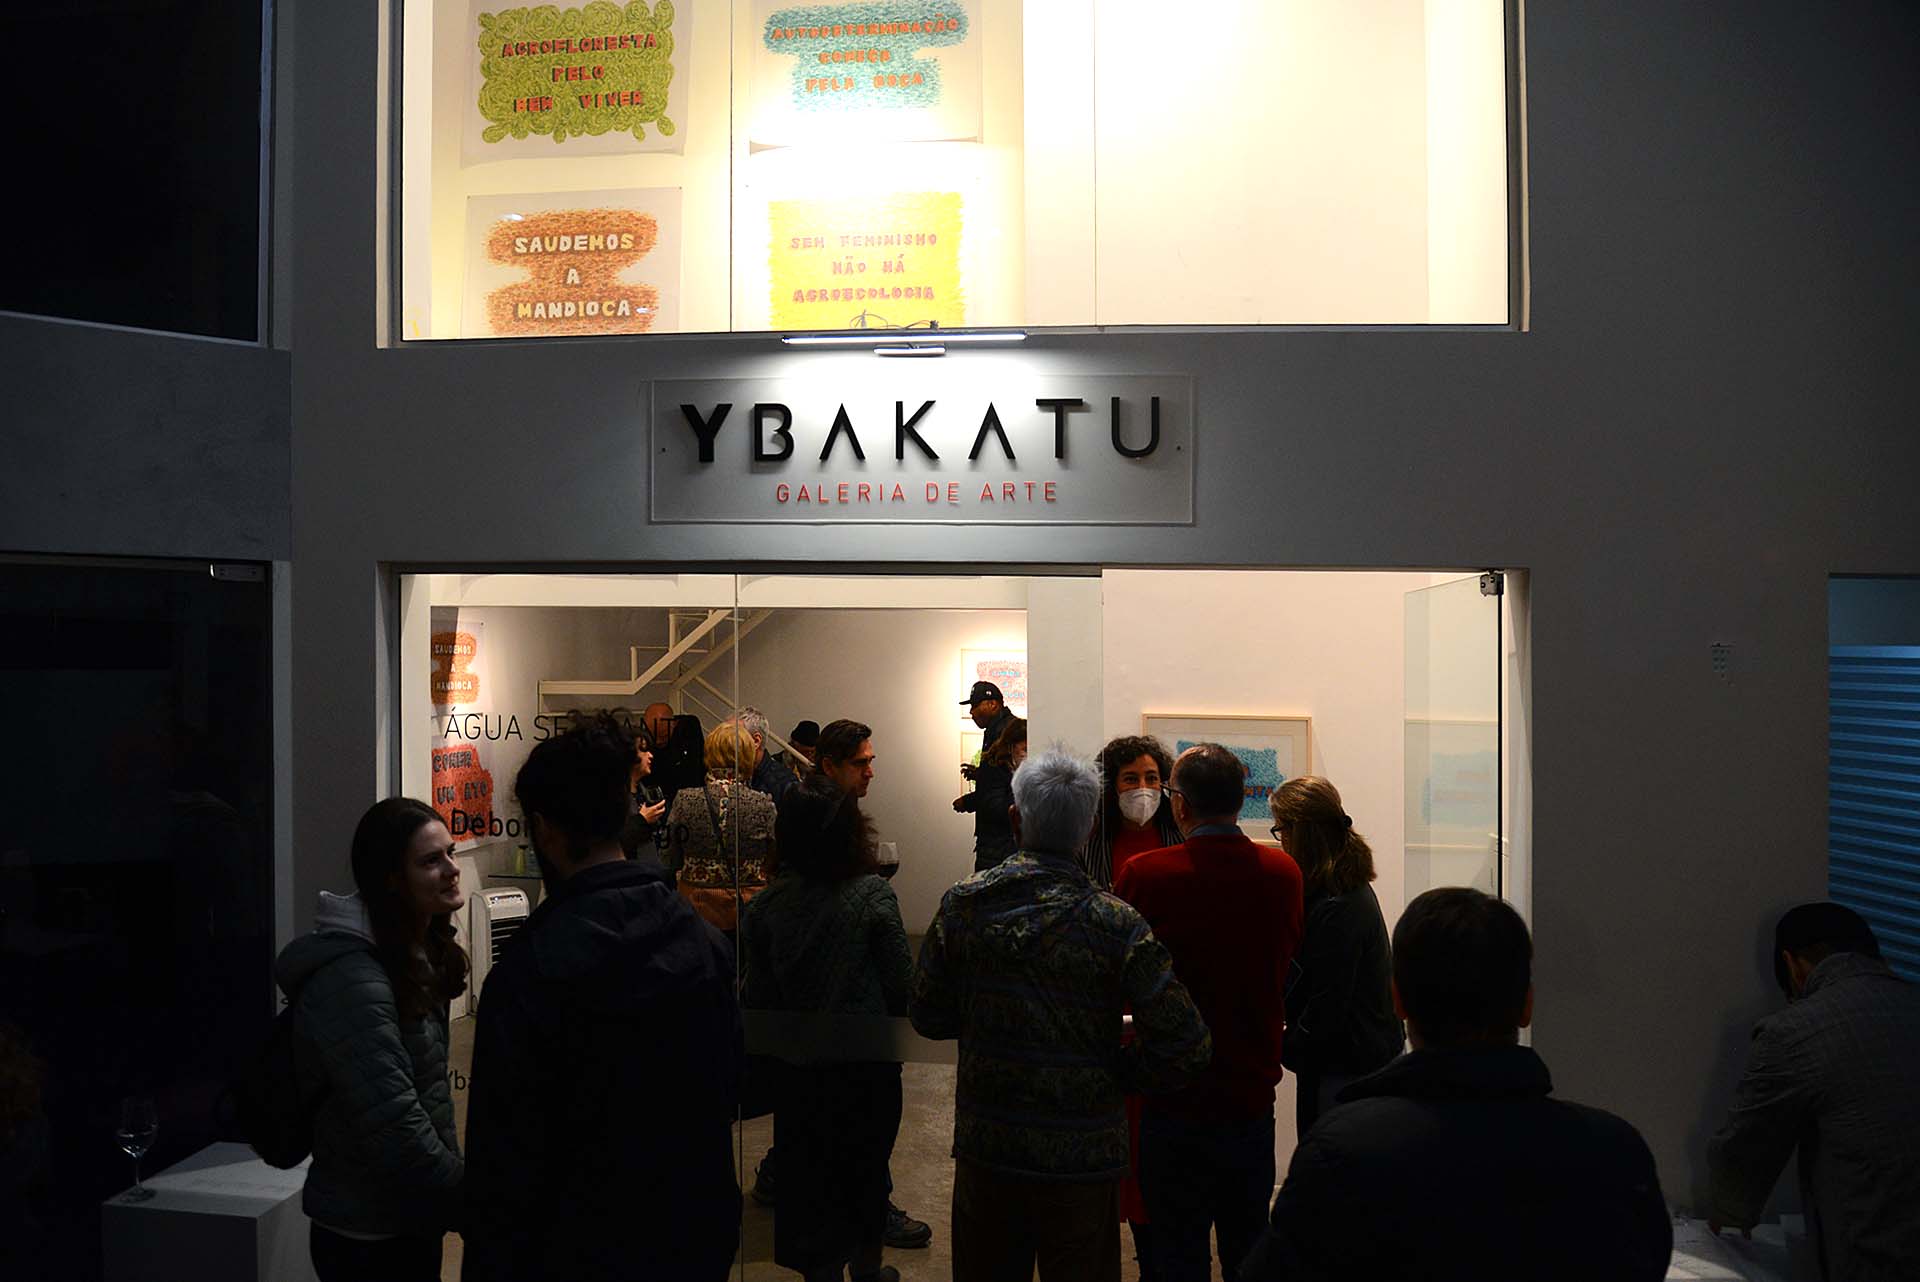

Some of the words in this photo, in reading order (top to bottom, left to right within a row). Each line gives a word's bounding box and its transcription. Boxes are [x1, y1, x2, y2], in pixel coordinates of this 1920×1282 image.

[503, 33, 657, 57] AGROFLORESTA
[552, 65, 605, 82] PELO
[806, 77, 854, 93] PELA
[579, 90, 642, 108] VIVER
[515, 233, 634, 253] SAUDEMOS
[791, 237, 825, 249] SEM
[840, 233, 937, 247] FEMINISMO
[566, 268, 580, 284] A
[793, 287, 935, 304] AGROECOLOGIA
[517, 300, 630, 318] MANDIOCA
[680, 397, 1159, 462] YBAKATU
[776, 482, 905, 503] GALERIA
[926, 482, 959, 502] DE
[980, 481, 1057, 502] ARTE
[435, 644, 472, 655] SAUDEMOS
[436, 680, 472, 691] MANDIOCA
[444, 706, 523, 740] ÁGUA
